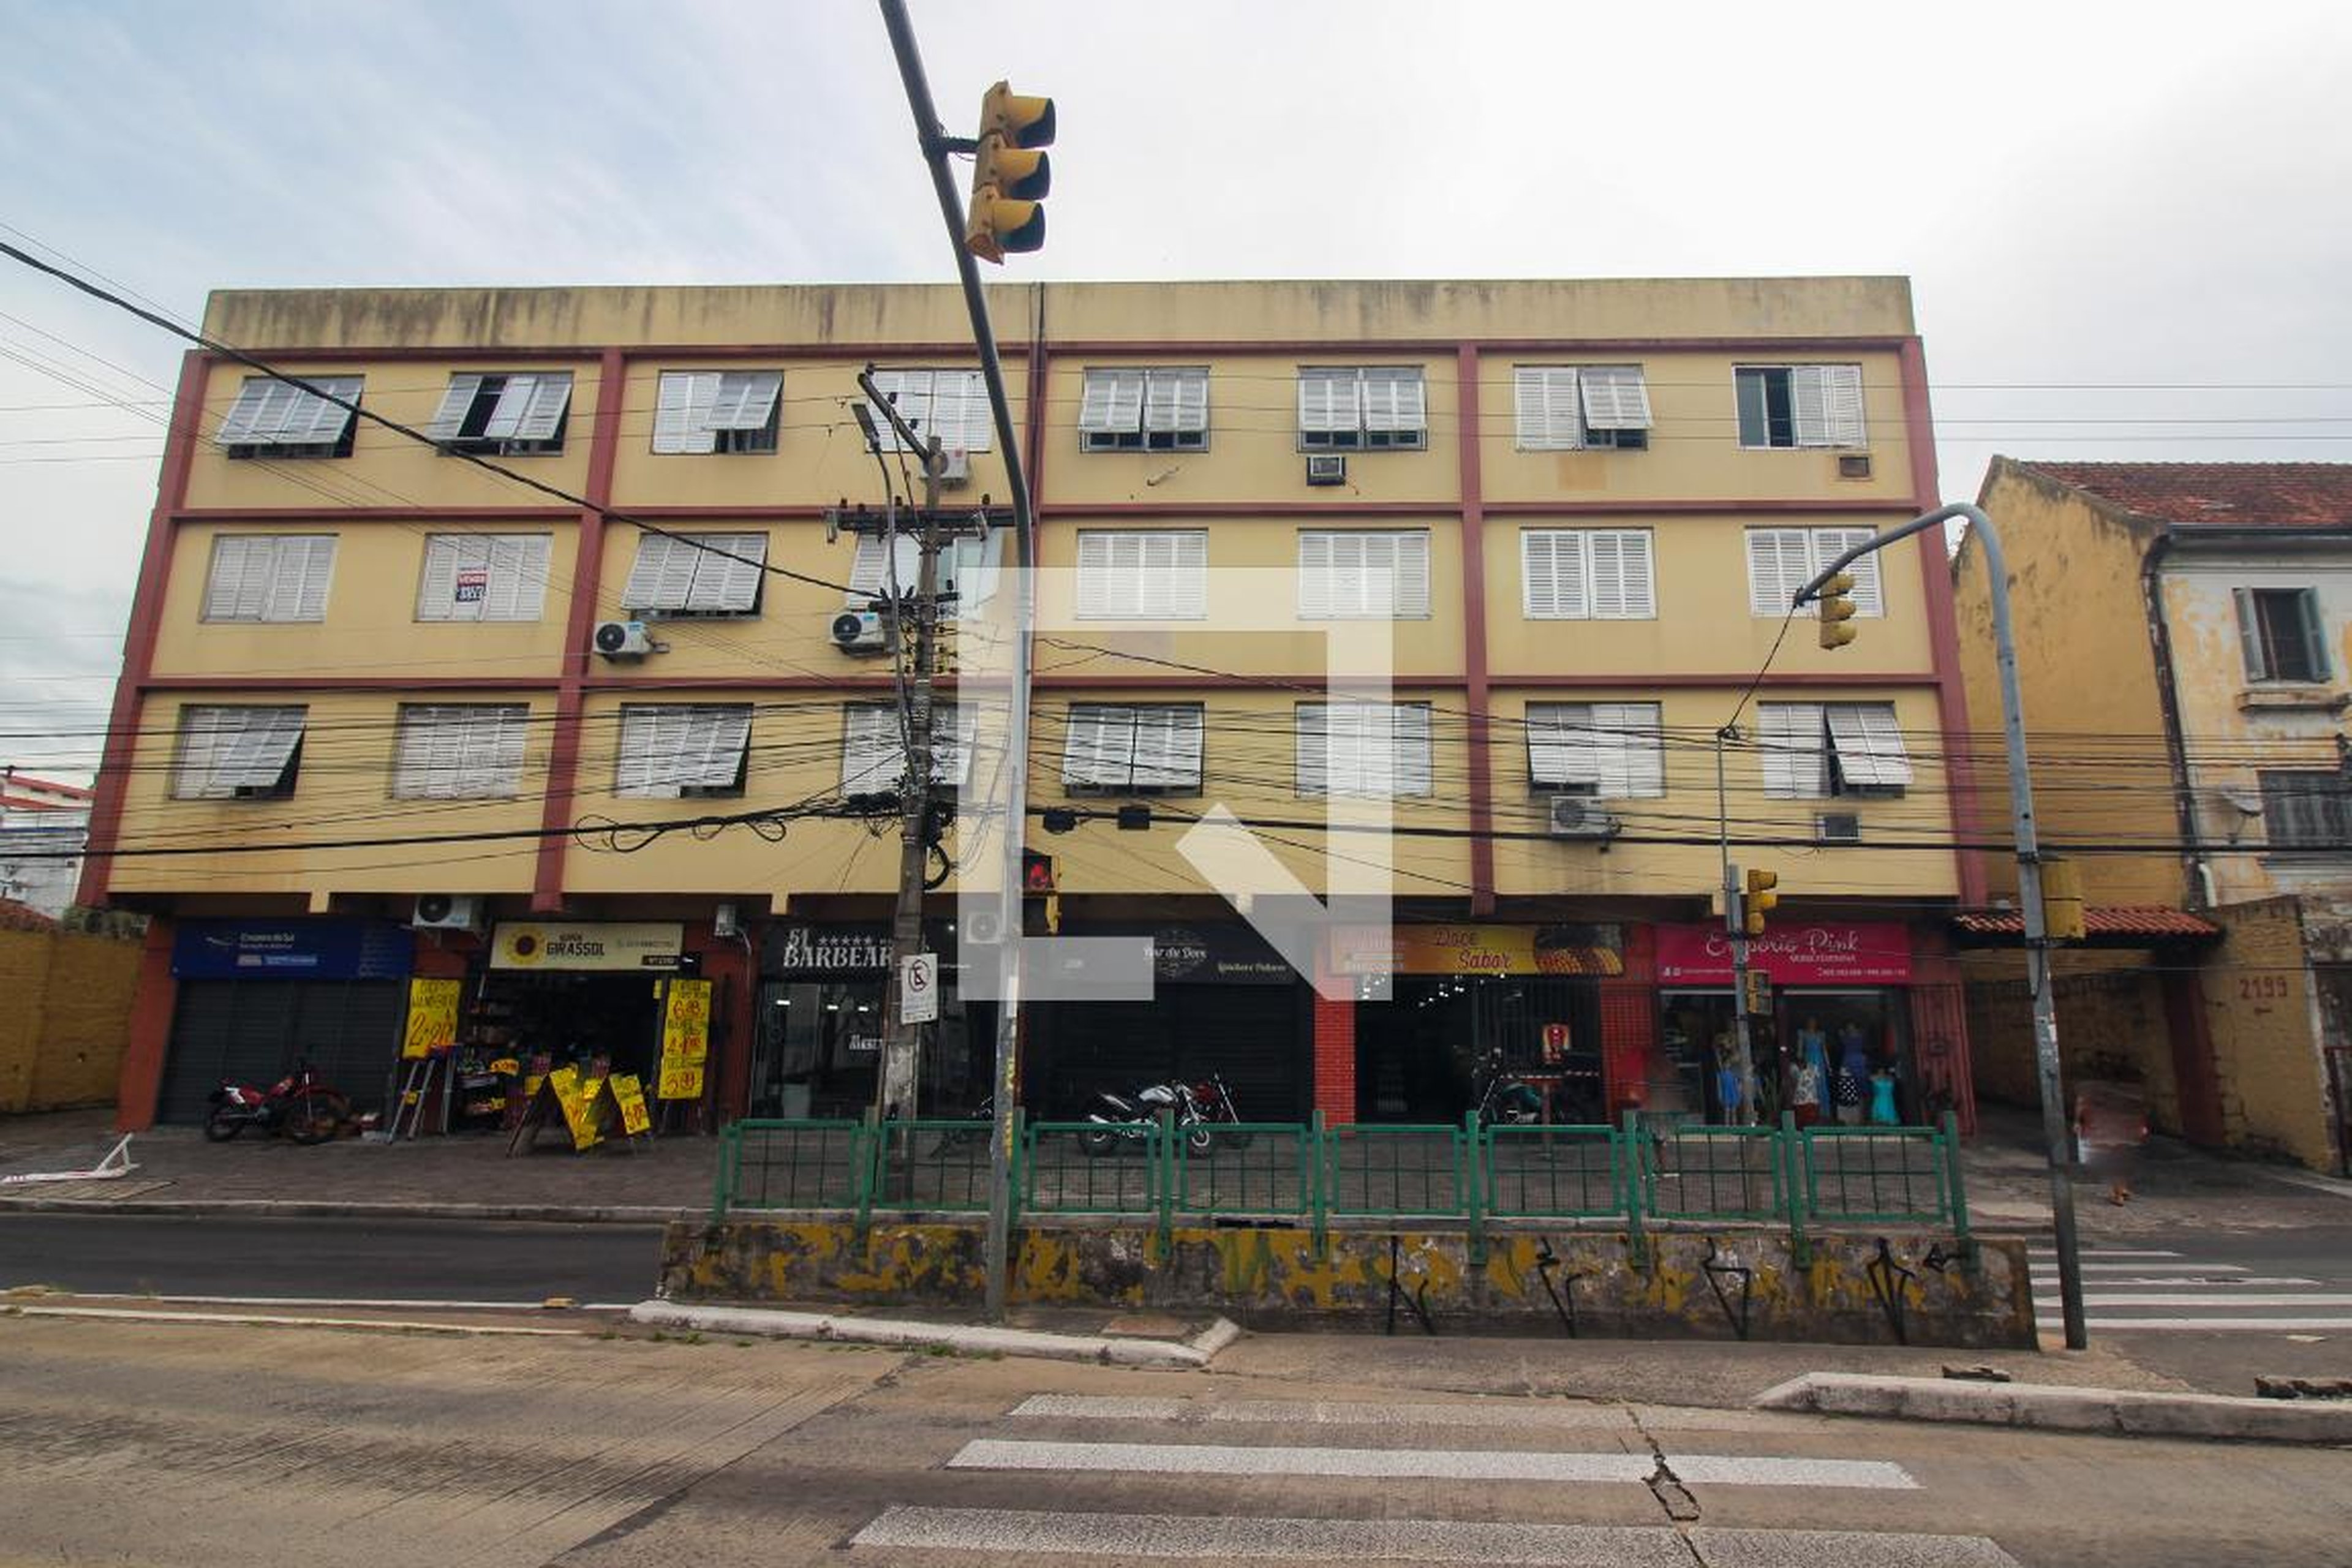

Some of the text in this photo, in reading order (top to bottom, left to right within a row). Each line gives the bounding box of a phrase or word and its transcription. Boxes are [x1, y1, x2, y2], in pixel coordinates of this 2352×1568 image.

[1436, 927, 1478, 946] Doce
[1807, 928, 1860, 954] Pink
[546, 942, 606, 957] GIRASSOL
[1457, 948, 1512, 970] Sabor
